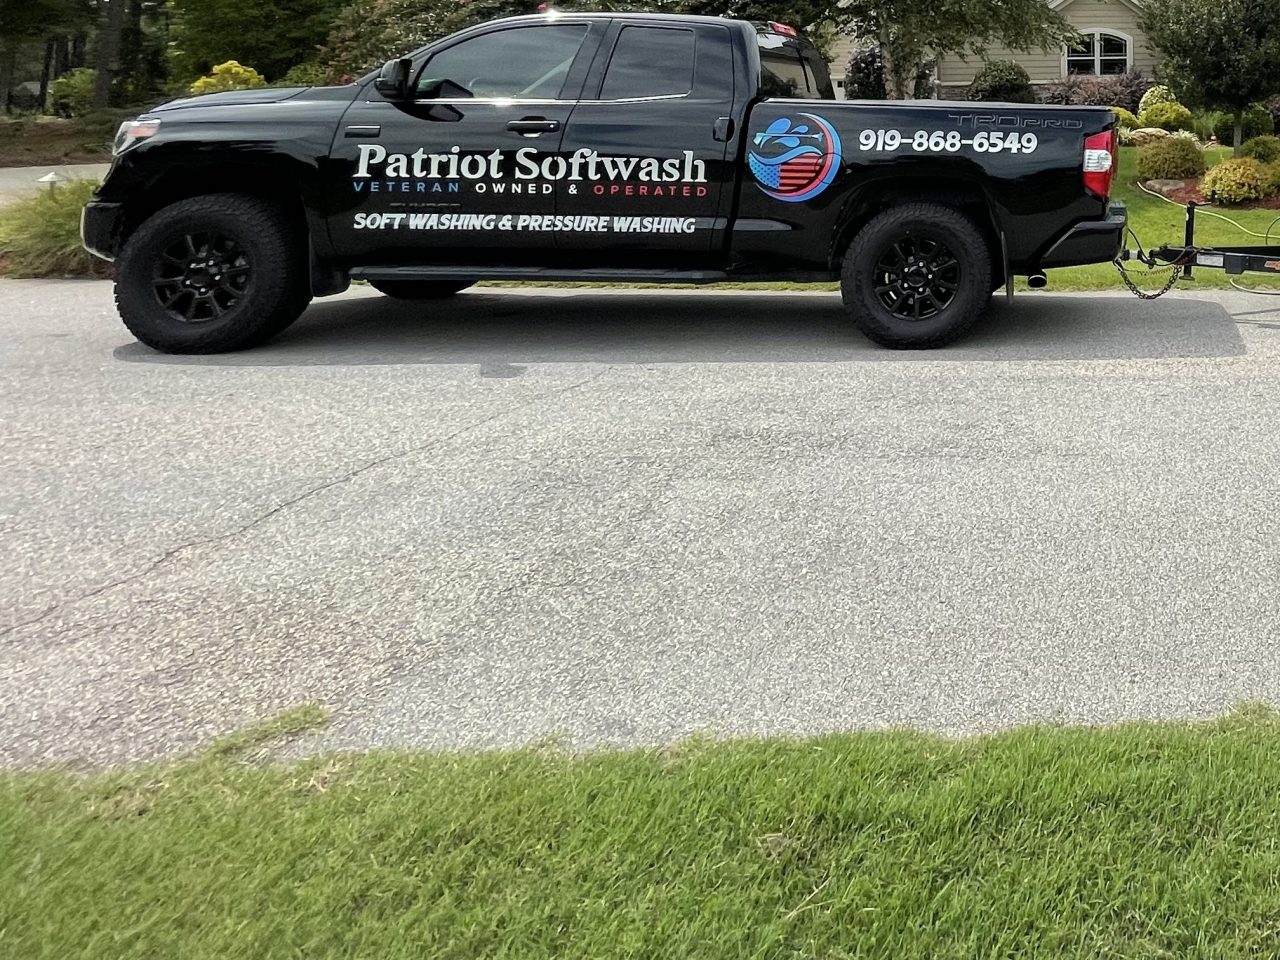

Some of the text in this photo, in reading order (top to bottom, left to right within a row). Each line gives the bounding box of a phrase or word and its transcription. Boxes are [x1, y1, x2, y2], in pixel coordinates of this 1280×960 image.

[858, 129, 1038, 154] 919-868-6549
[352, 144, 708, 183] Patriot Softwash
[353, 182, 708, 197] VETERAN OWNED & OPERATED
[353, 213, 696, 234] SOFT WASHING & PRESSURE WASHING
